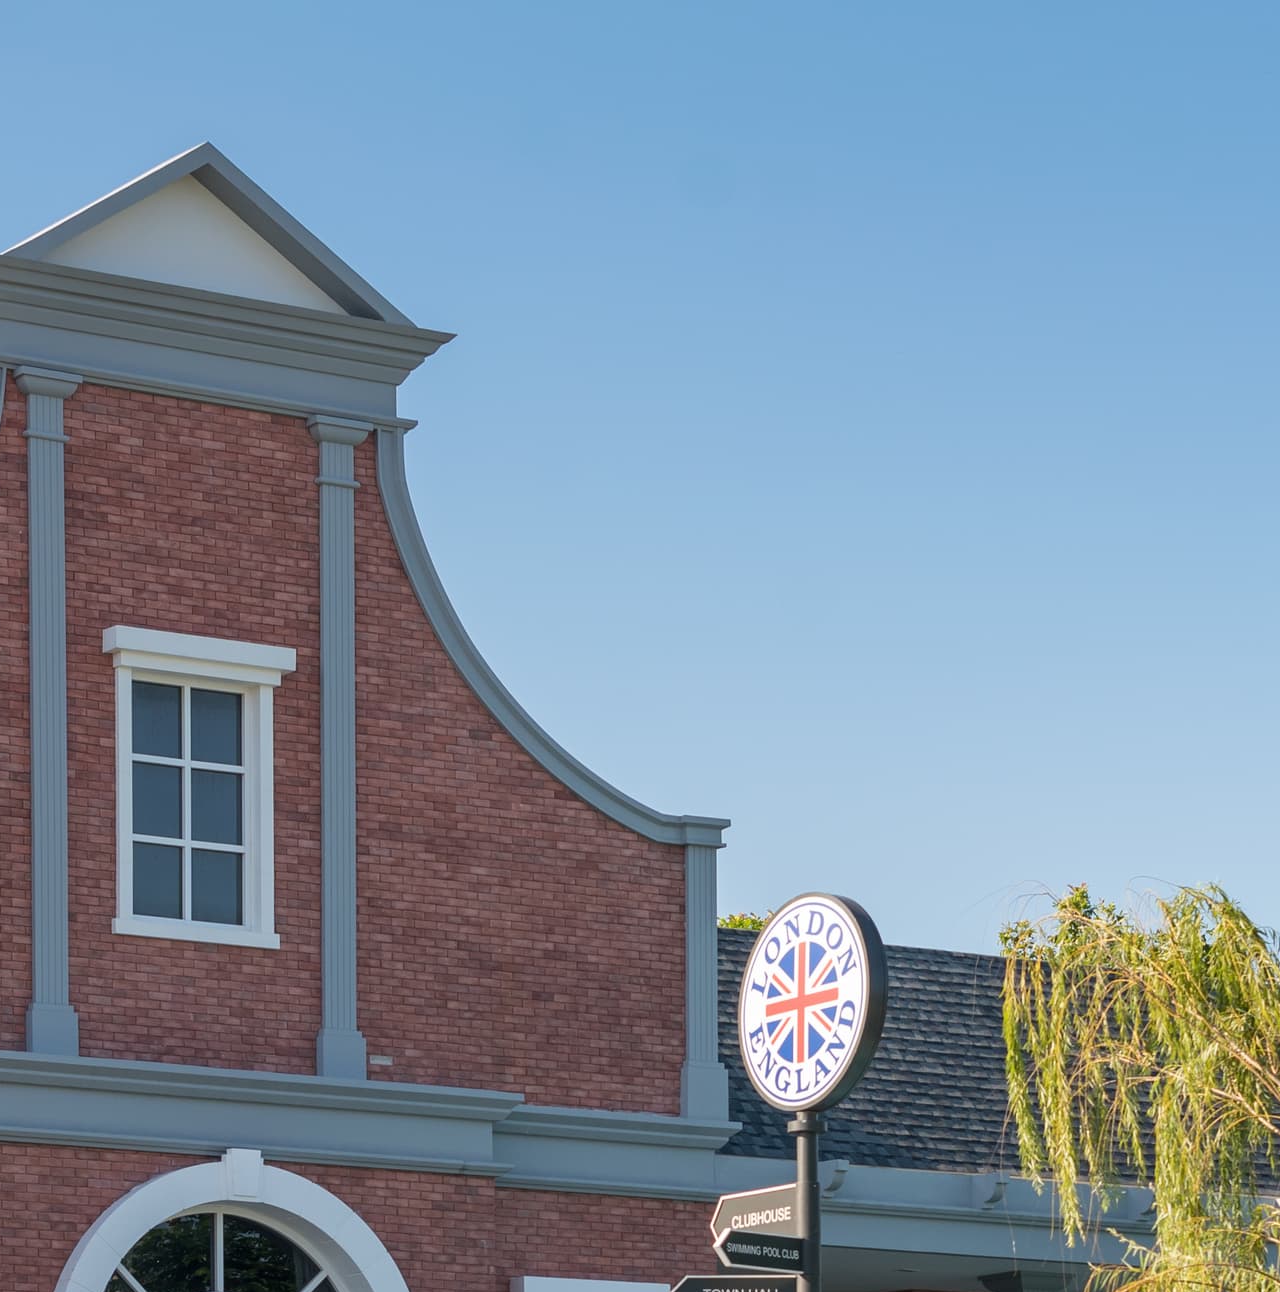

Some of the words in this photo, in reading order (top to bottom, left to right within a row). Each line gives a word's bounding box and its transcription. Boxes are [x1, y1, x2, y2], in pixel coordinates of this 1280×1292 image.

[751, 910, 857, 996] LONDON
[749, 1000, 856, 1094] ENGLAND
[731, 1206, 792, 1229] CLUBHOUSE
[726, 1242, 761, 1256] SWIMMING
[762, 1246, 781, 1258] POOL
[781, 1248, 800, 1260] CLUB
